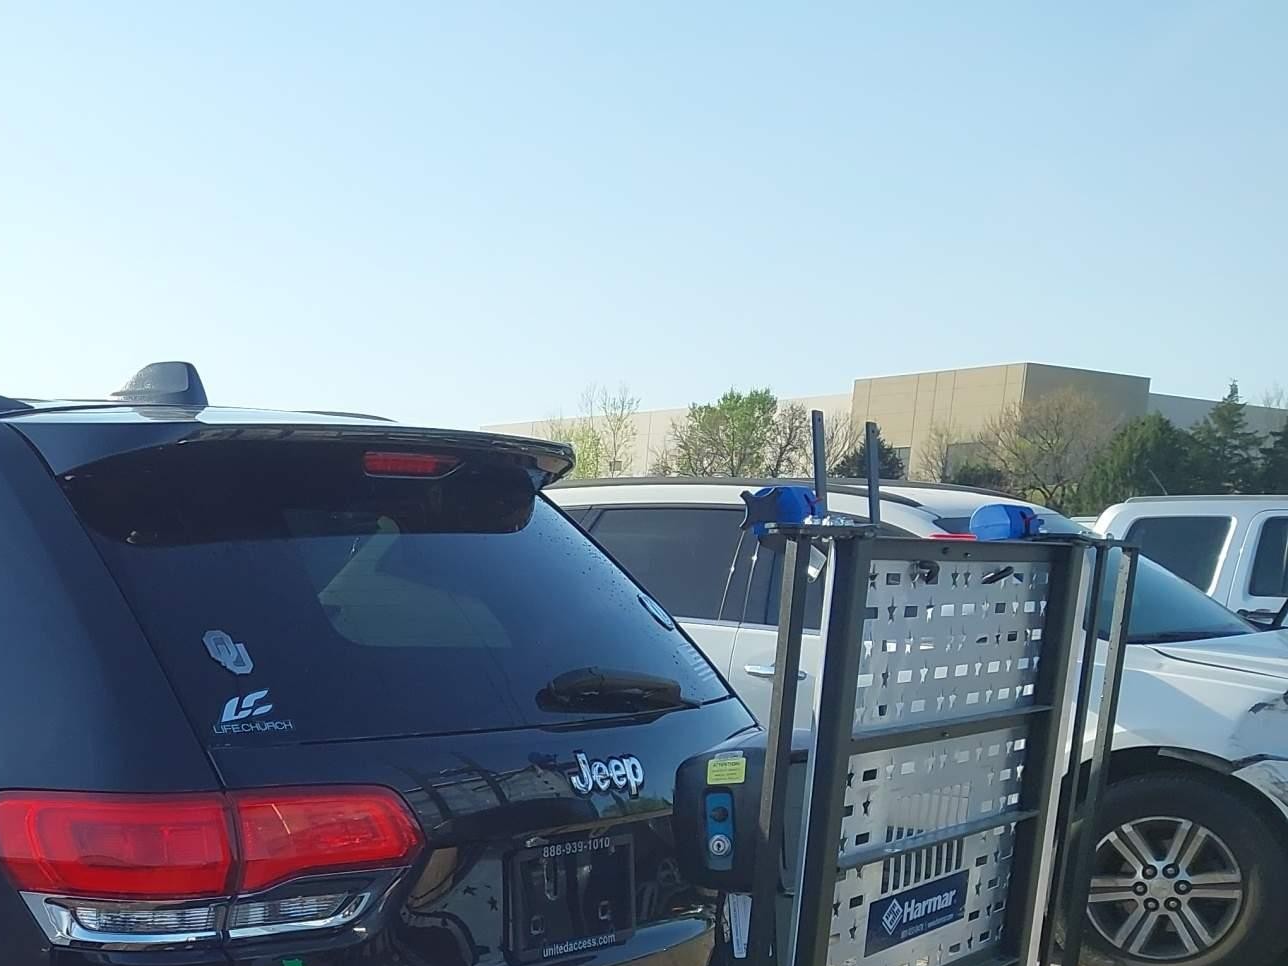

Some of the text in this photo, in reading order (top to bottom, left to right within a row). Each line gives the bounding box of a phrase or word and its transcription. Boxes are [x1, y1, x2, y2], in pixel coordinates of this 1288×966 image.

[571, 751, 644, 796] Jeep
[543, 836, 611, 857] 888-939-1010
[902, 889, 956, 923] Harmar
[542, 932, 616, 958] unitedaccess.com
